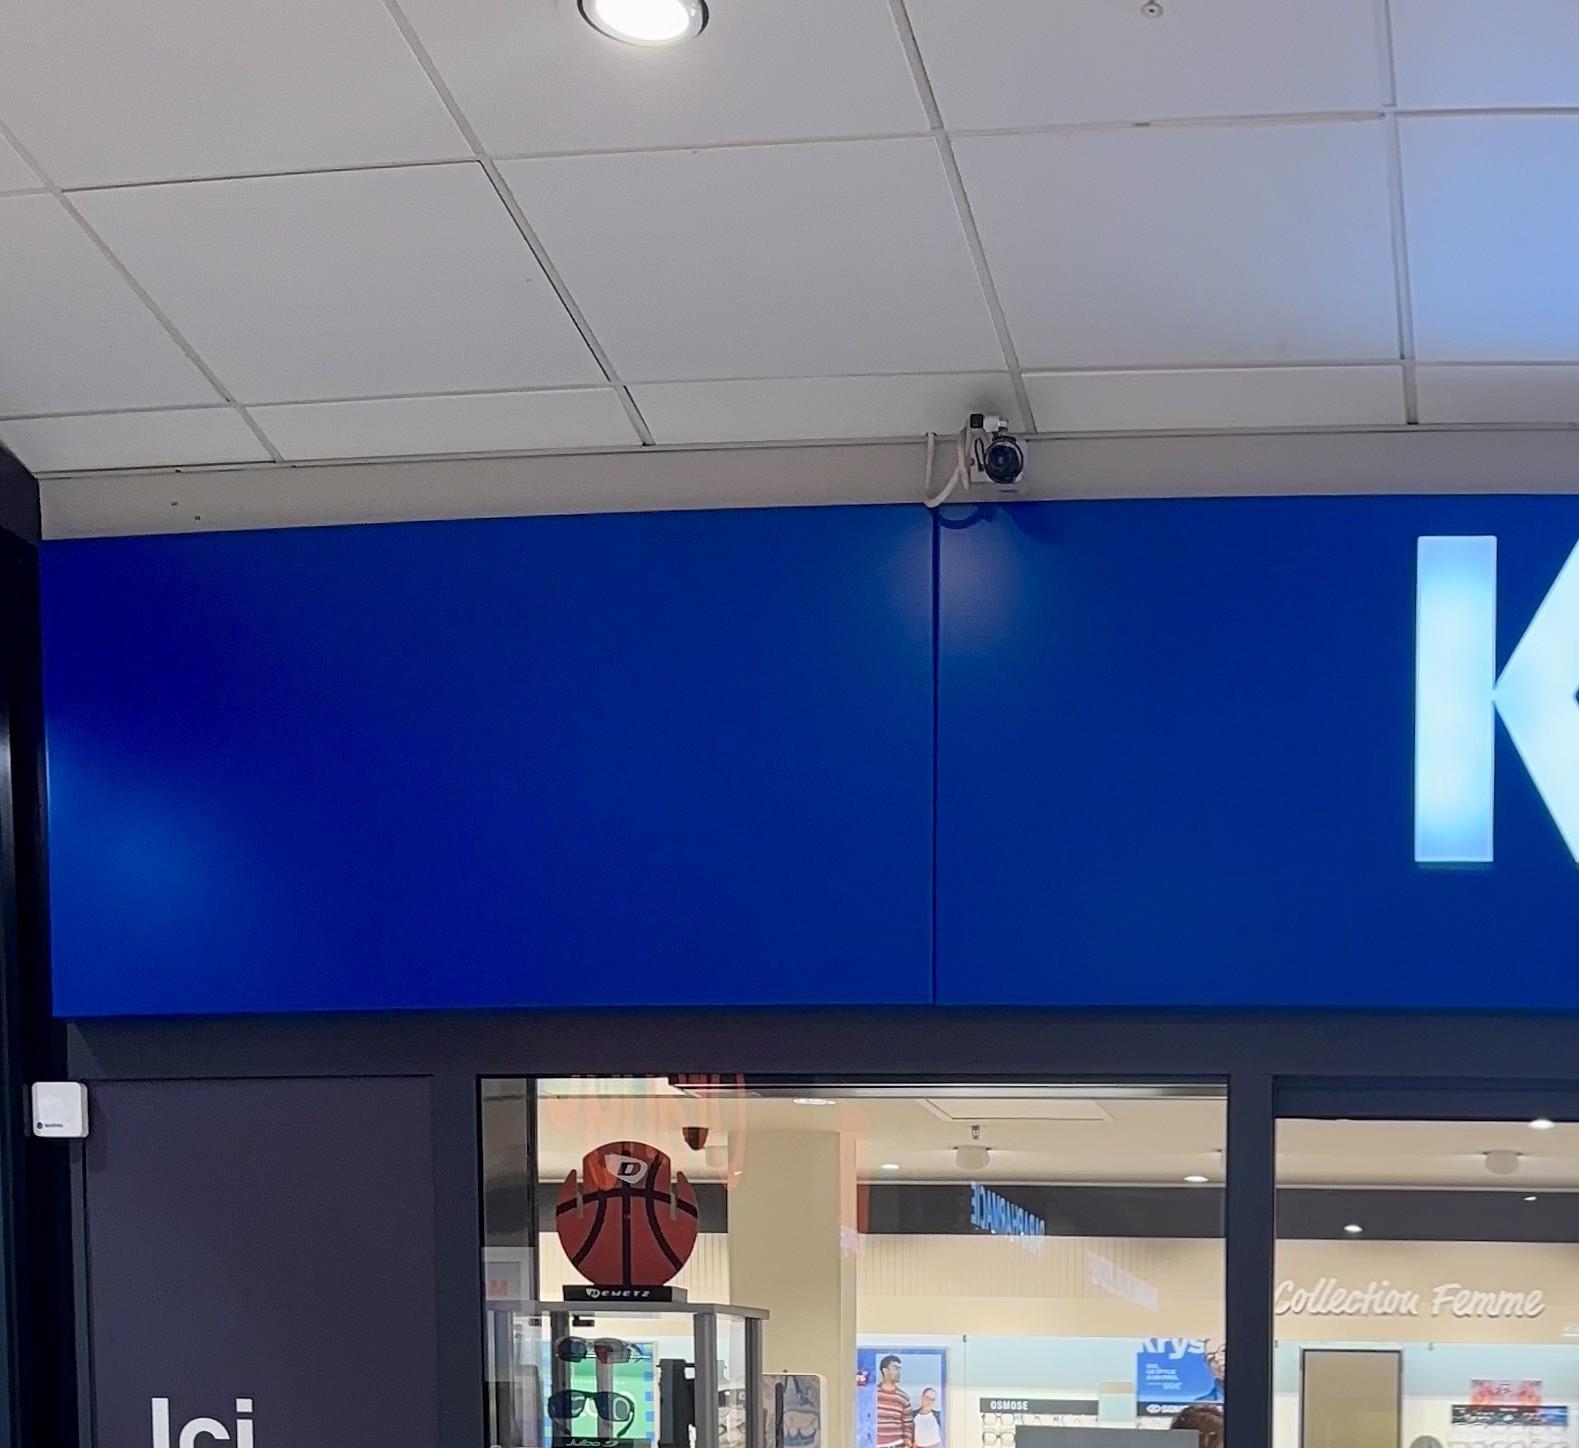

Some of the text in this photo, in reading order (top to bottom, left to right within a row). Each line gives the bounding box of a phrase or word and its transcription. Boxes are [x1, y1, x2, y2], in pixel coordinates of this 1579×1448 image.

[1273, 1277, 1546, 1318] Collection Femme
[990, 1401, 1029, 1411] OSMOSE
